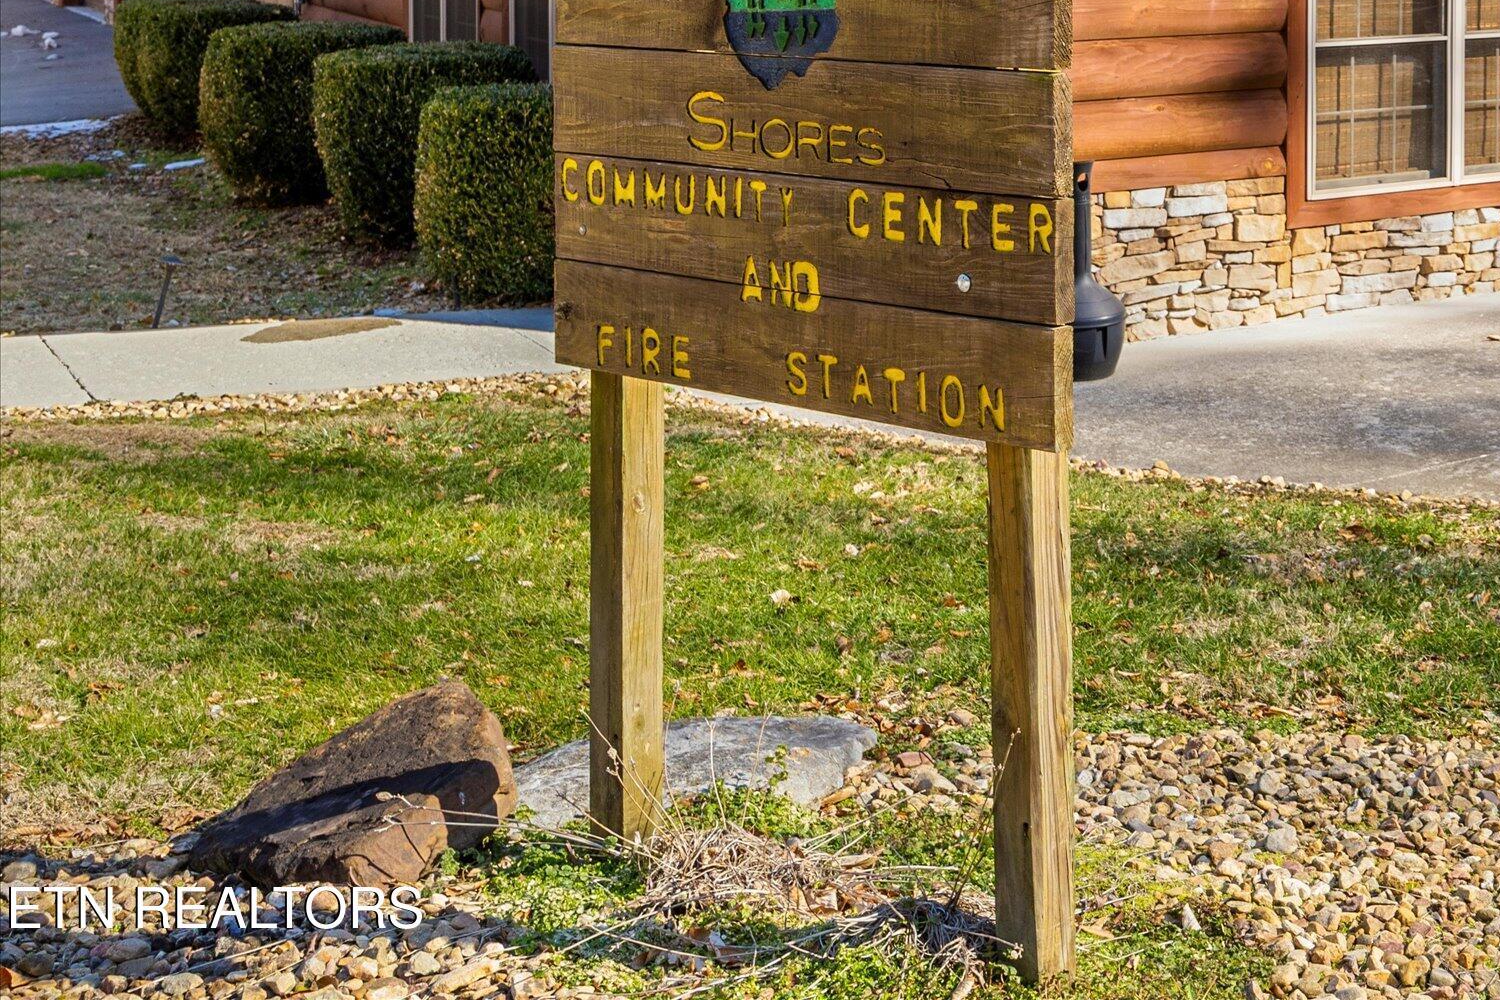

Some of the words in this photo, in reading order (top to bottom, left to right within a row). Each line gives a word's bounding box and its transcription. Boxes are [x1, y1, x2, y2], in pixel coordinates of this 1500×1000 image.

[687, 90, 886, 167] SHORES
[560, 157, 794, 228] COMMUNITY
[846, 187, 1054, 255] CENTER
[740, 254, 823, 314] AND
[596, 324, 692, 379] FIRE
[786, 351, 1006, 433] STATION
